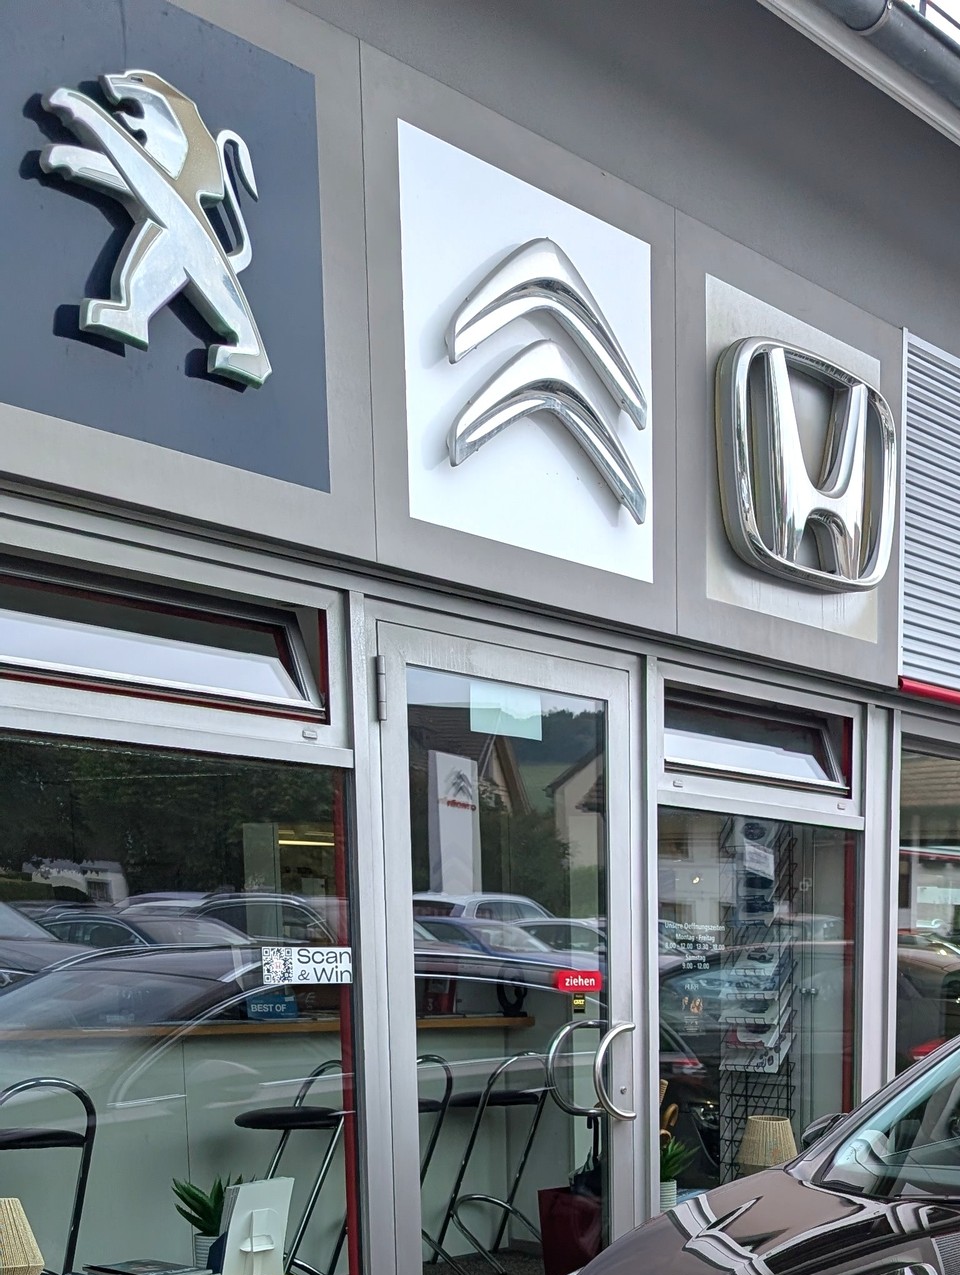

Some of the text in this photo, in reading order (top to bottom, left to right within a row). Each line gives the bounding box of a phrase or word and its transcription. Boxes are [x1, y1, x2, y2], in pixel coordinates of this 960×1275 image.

[675, 933, 695, 942] Montag
[698, 934, 716, 943] Freitag
[297, 948, 351, 964] Scan
[685, 953, 706, 962] Samstag
[697, 962, 710, 970] 12.00
[297, 965, 352, 983] & Win
[565, 974, 596, 987] ziehen
[251, 1003, 287, 1012] BEST OF
